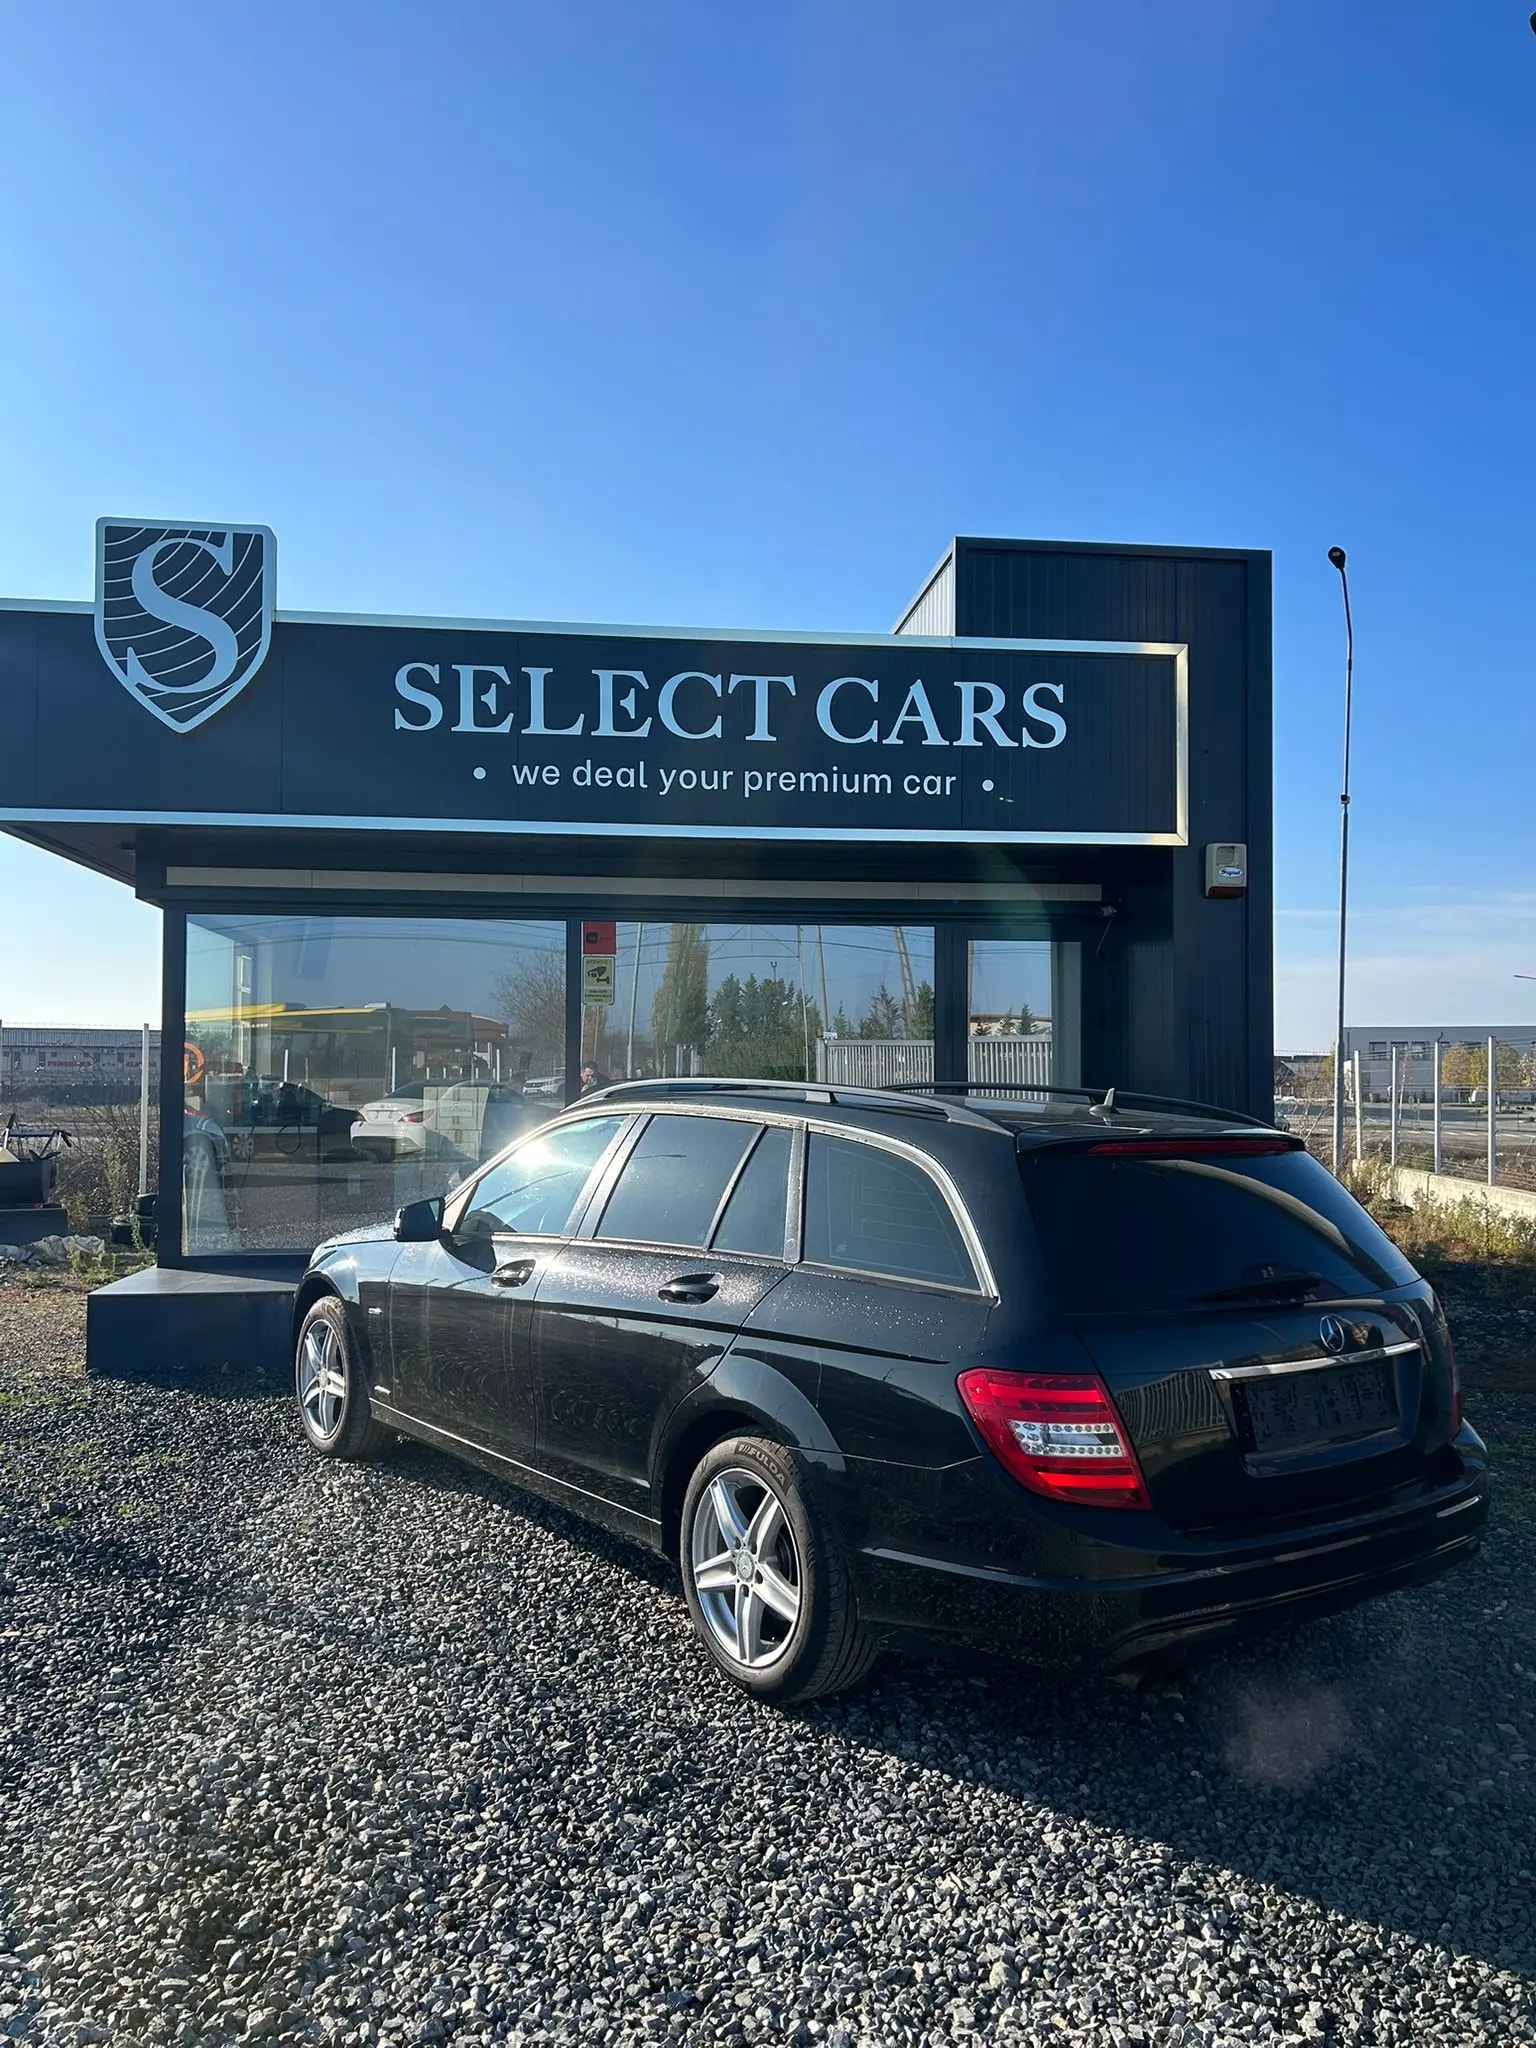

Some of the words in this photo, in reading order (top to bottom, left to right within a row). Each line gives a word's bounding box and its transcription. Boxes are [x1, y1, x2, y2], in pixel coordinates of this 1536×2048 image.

[127, 530, 238, 693] S
[394, 662, 797, 742] SELECT
[816, 677, 1068, 749] CARS
[512, 764, 561, 785] we
[572, 759, 648, 788] deal
[659, 767, 734, 796] your
[744, 766, 893, 798] premium
[903, 774, 957, 796] car
[748, 1447, 786, 1487] FULDA
